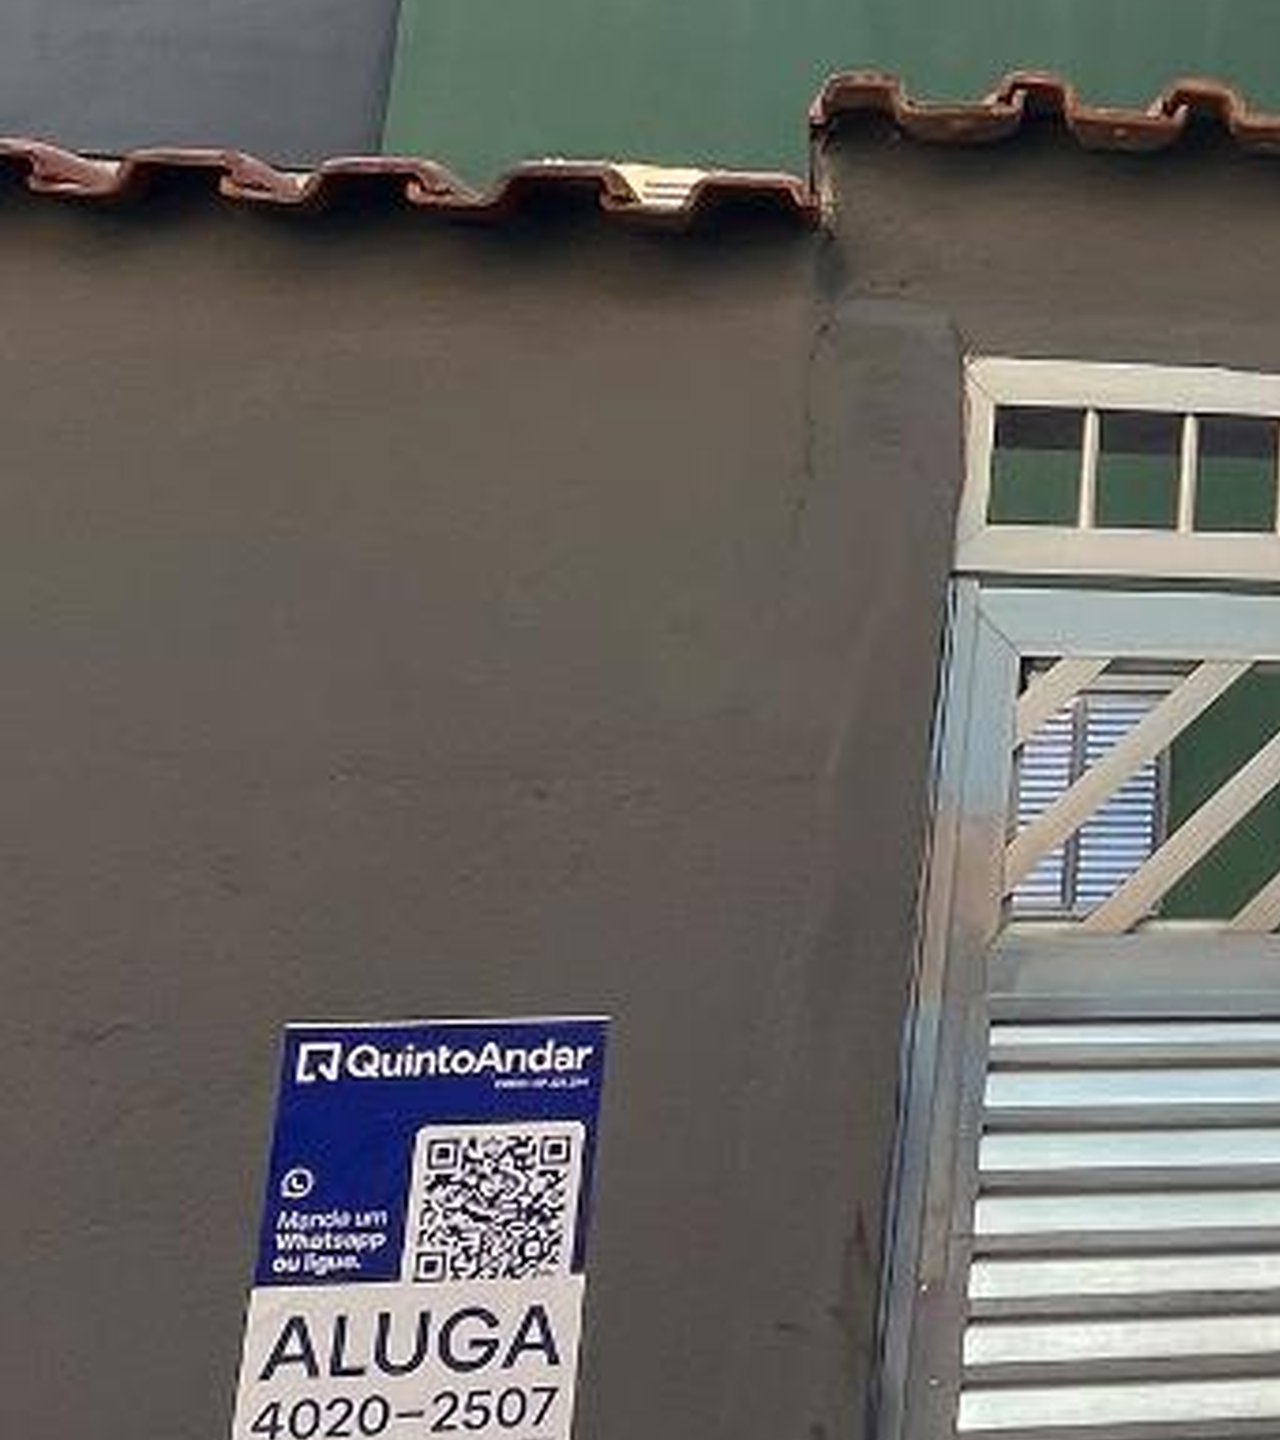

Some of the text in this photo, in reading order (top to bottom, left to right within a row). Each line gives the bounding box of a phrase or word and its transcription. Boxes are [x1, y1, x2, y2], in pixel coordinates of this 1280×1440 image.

[346, 1040, 594, 1079] QuintoAndar
[276, 1209, 387, 1230] Mande um
[273, 1256, 300, 1272] ou
[258, 1305, 561, 1381] ALUGA
